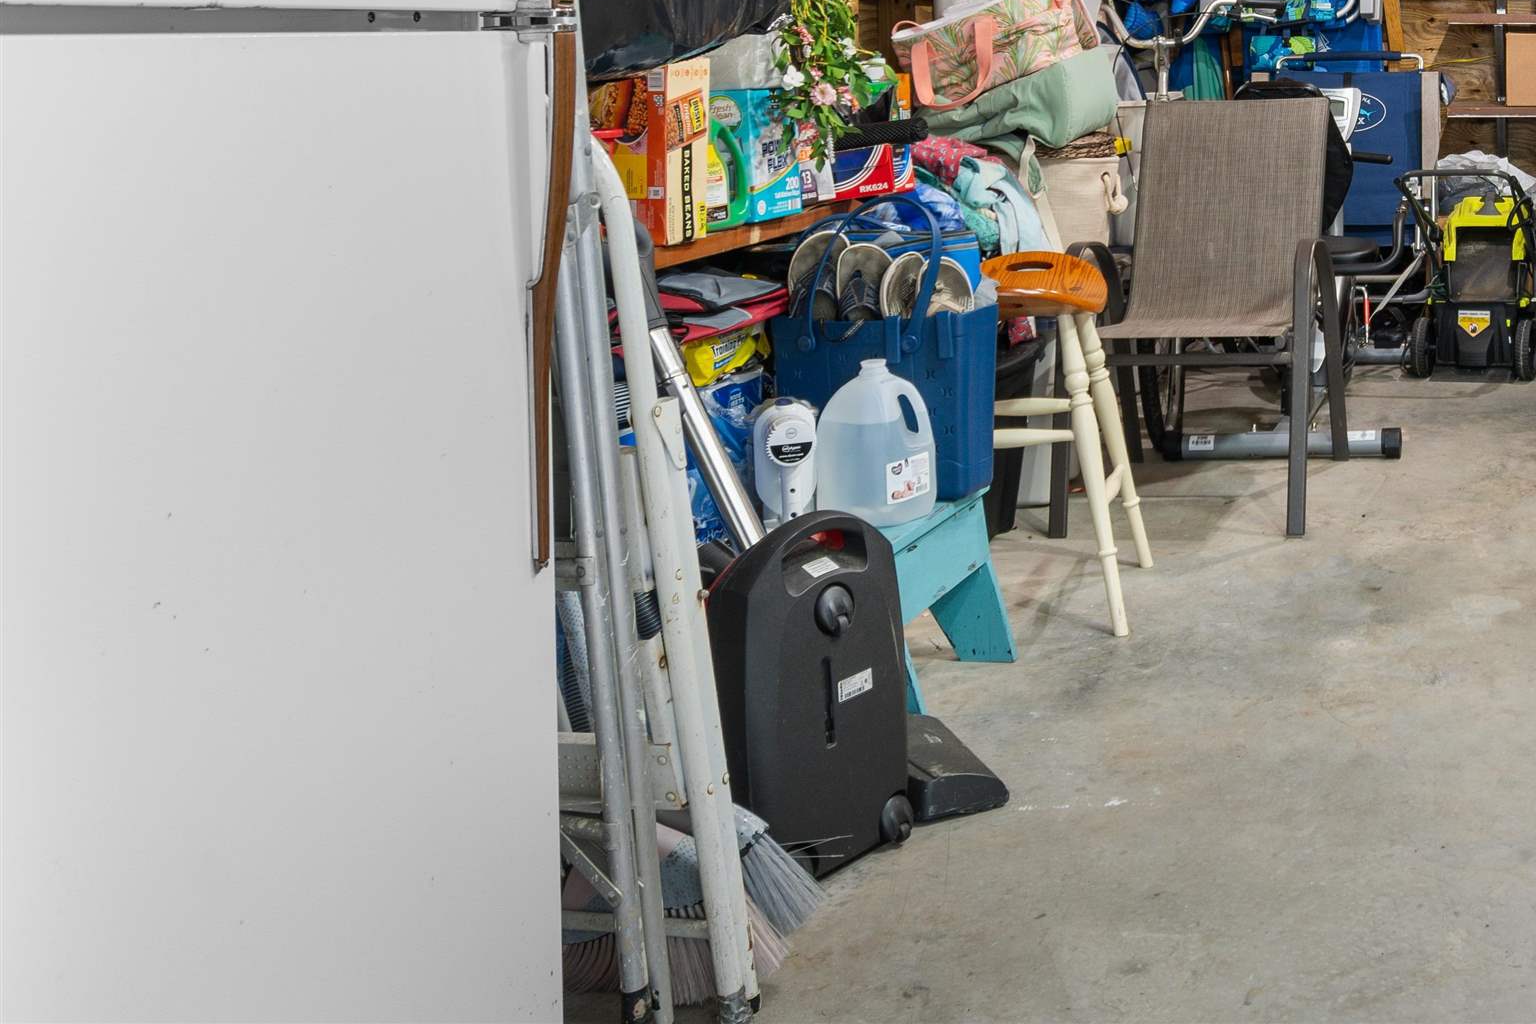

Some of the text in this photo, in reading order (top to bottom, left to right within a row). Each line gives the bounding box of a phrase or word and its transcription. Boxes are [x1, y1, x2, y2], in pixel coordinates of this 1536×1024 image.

[785, 176, 799, 190] 200
[802, 170, 812, 183] 13
[683, 149, 694, 239] BAKED BEANS
